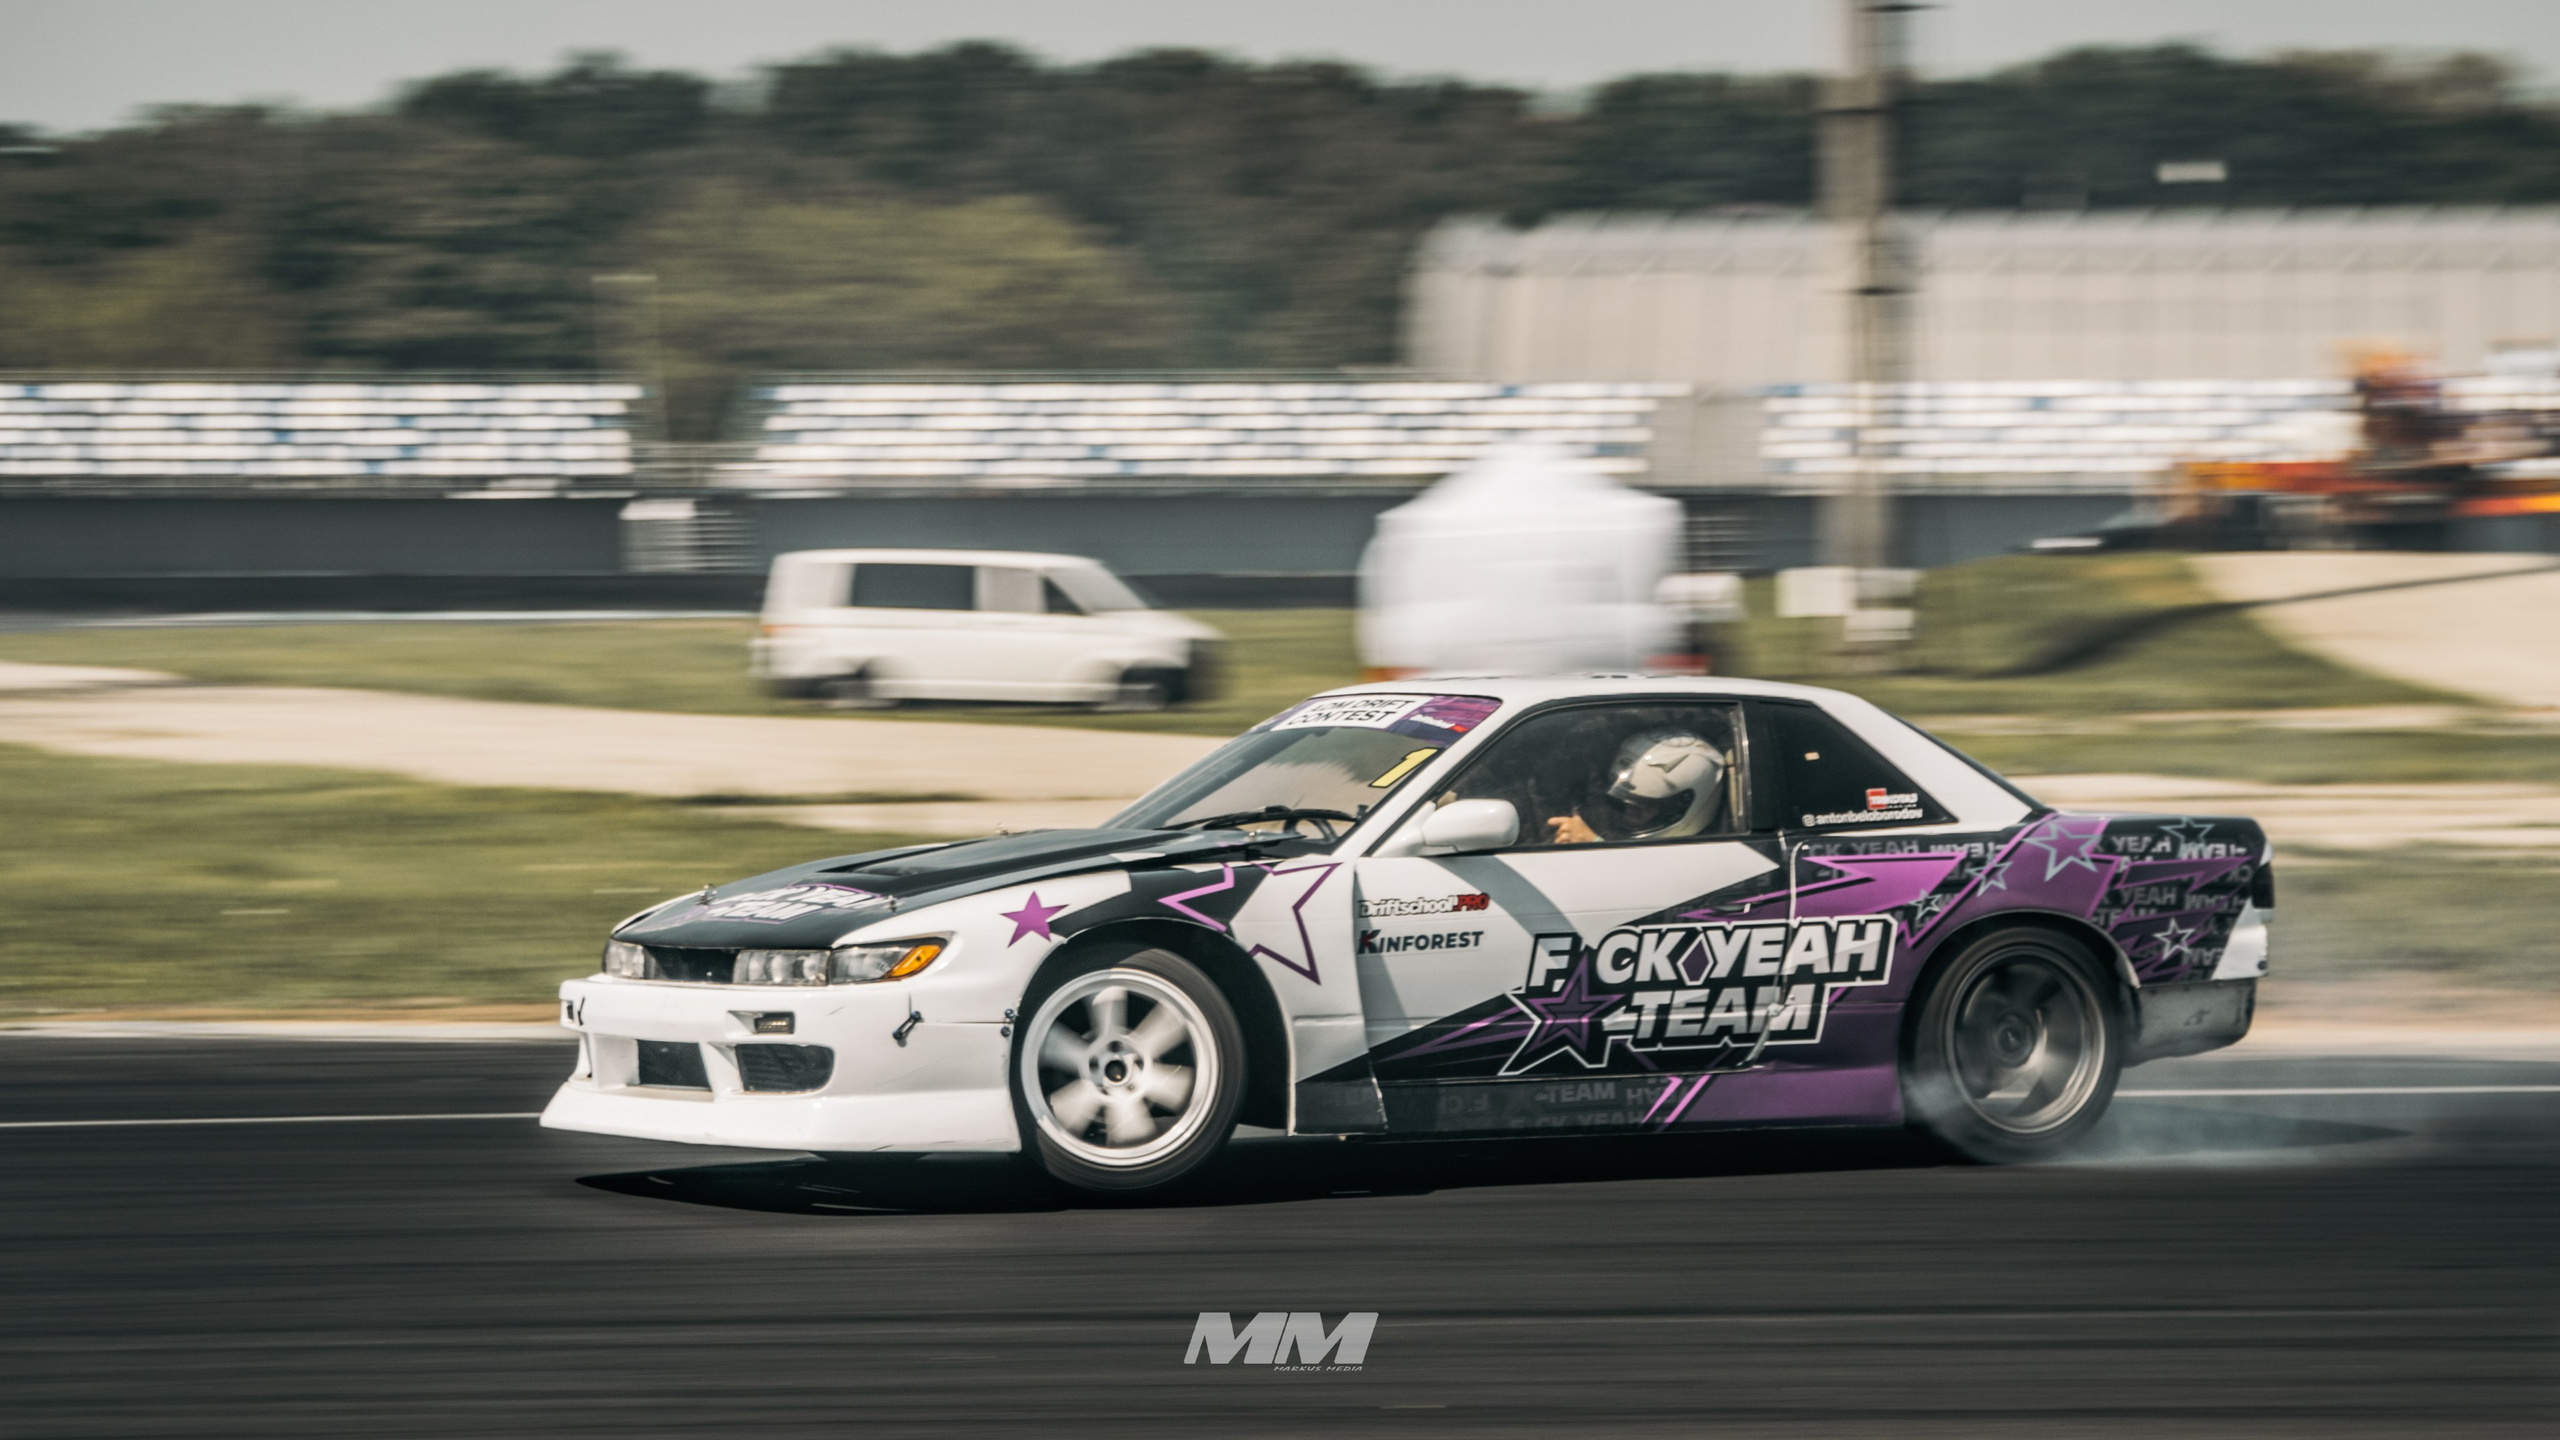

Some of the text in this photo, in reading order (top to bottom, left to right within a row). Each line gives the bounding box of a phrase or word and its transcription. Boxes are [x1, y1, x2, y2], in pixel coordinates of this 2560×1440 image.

[1353, 699, 1415, 710] DRIFT
[1287, 710, 1396, 725] CONTEST
[1369, 748, 1438, 788] 1
[1358, 929, 1484, 954] KINFOREST
[1704, 921, 1885, 981] YEAH
